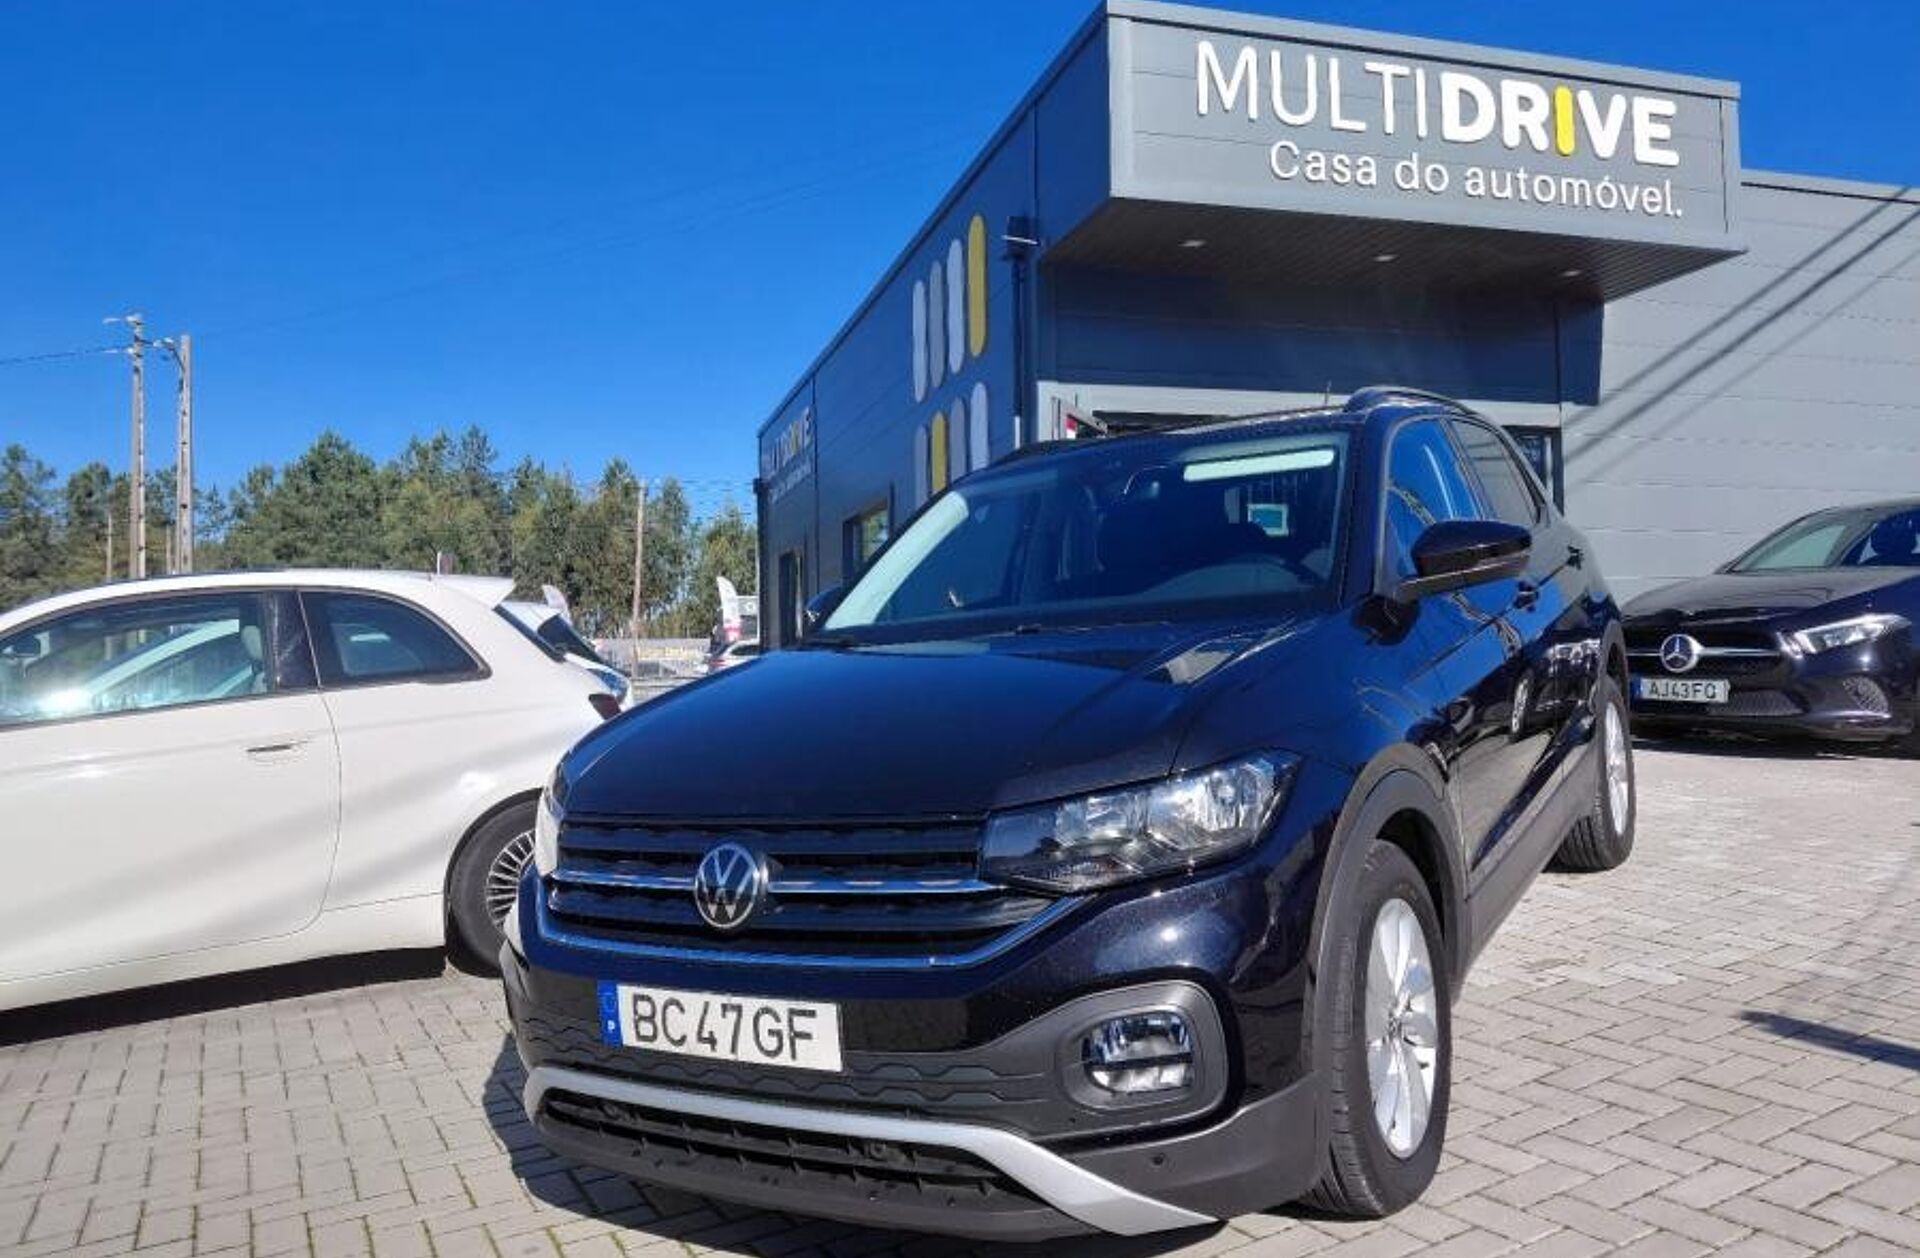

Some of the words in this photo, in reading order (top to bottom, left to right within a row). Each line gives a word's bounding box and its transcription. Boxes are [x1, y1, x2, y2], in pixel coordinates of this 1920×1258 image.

[1198, 40, 1680, 167] MULTIDRIVE
[1269, 141, 1379, 186] Casa
[1395, 153, 1450, 193] do
[1464, 167, 1684, 218] automóvel.
